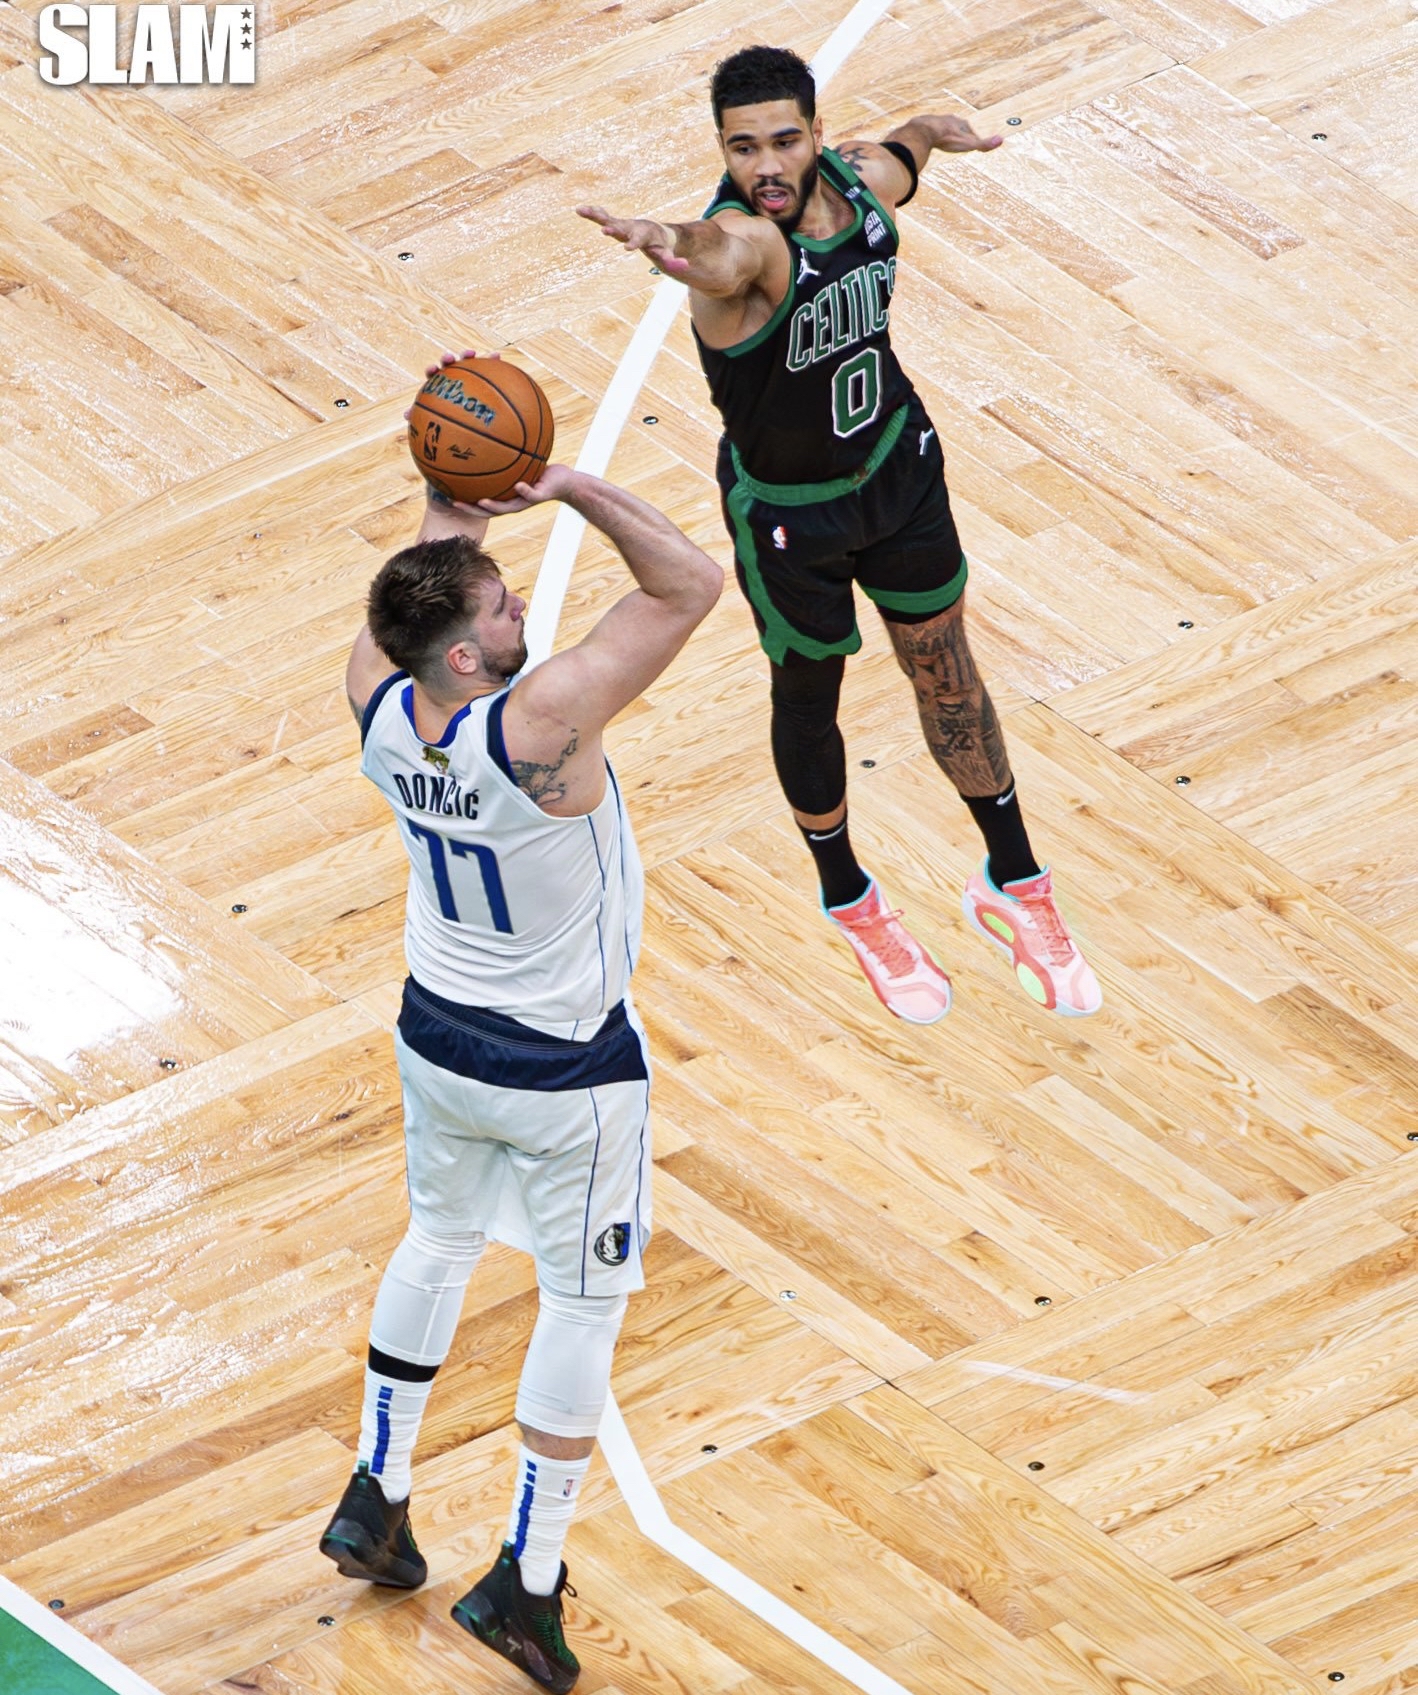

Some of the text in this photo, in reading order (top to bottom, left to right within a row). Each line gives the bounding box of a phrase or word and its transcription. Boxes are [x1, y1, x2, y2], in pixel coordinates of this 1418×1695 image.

[422, 374, 496, 427] Wilson
[832, 347, 882, 439] 0
[405, 817, 515, 936] 77
